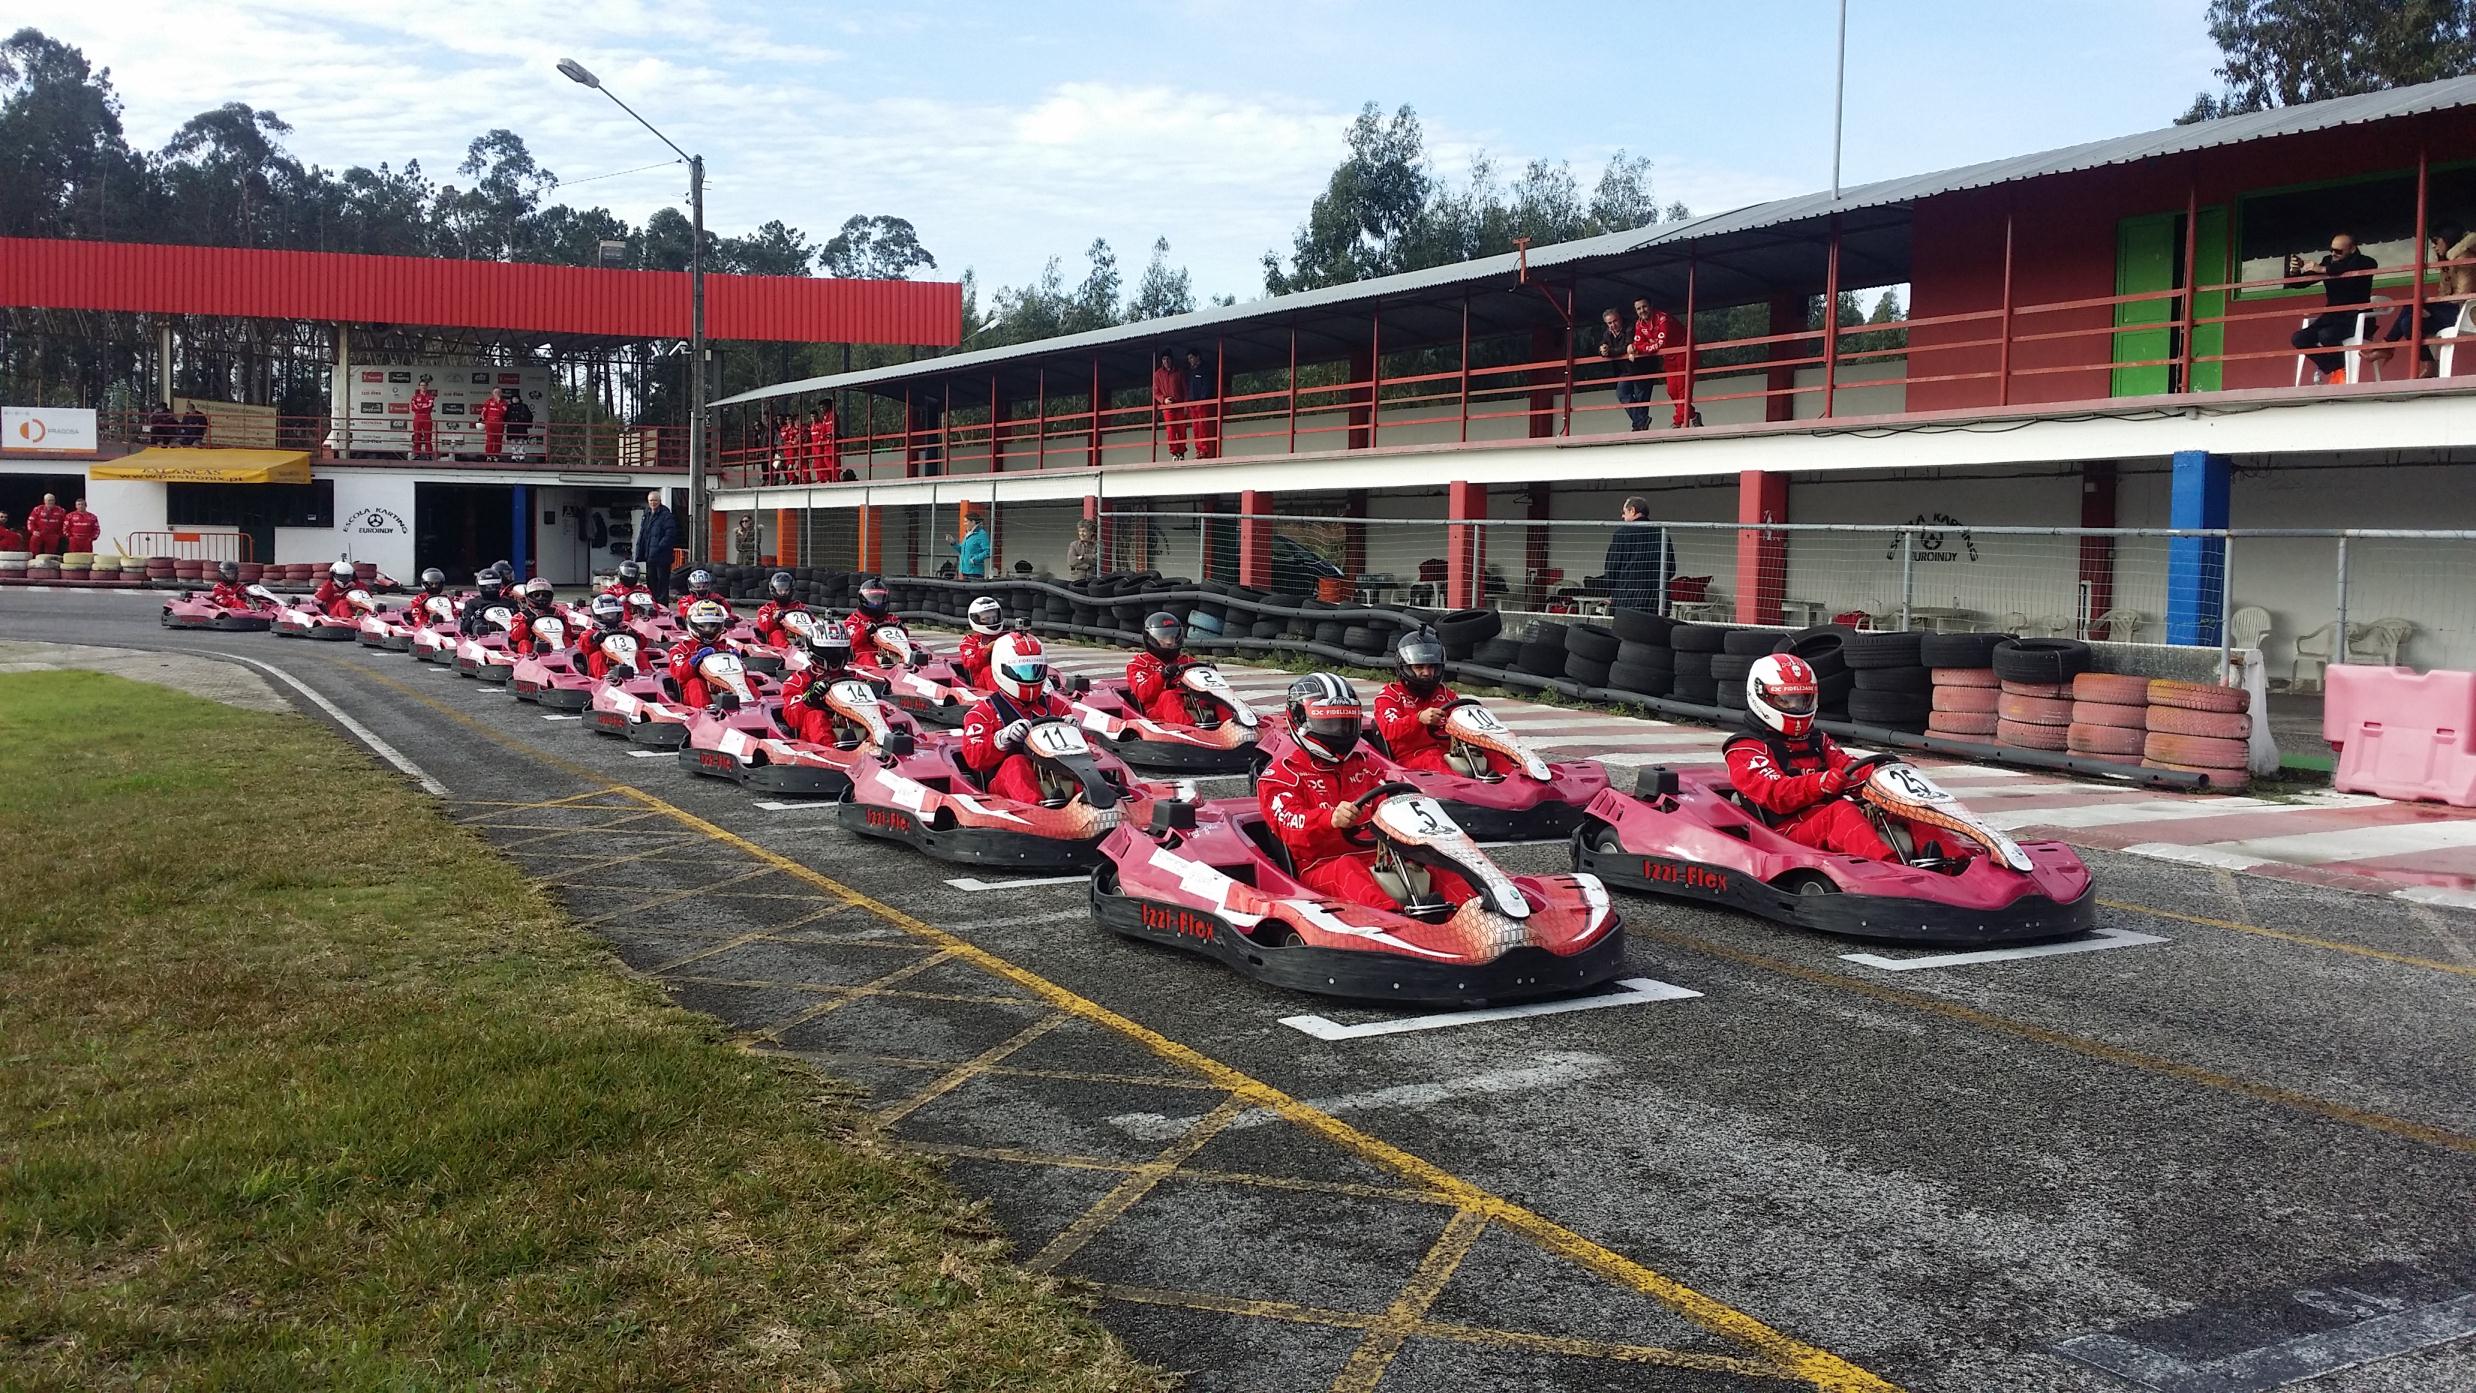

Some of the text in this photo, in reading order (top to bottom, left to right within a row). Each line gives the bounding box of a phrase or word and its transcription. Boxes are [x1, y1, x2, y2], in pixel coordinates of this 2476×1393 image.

[343, 507, 408, 534] ESCOLA KARTING
[793, 613, 807, 625] 20
[611, 636, 627, 649] 13
[883, 630, 904, 641] 24
[722, 657, 732, 669] 7
[1200, 670, 1217, 683] 2
[847, 684, 868, 700] 14
[1468, 709, 1496, 726] 10
[1043, 727, 1069, 749] 11
[1889, 769, 1931, 795] 25
[1409, 801, 1438, 830] 5
